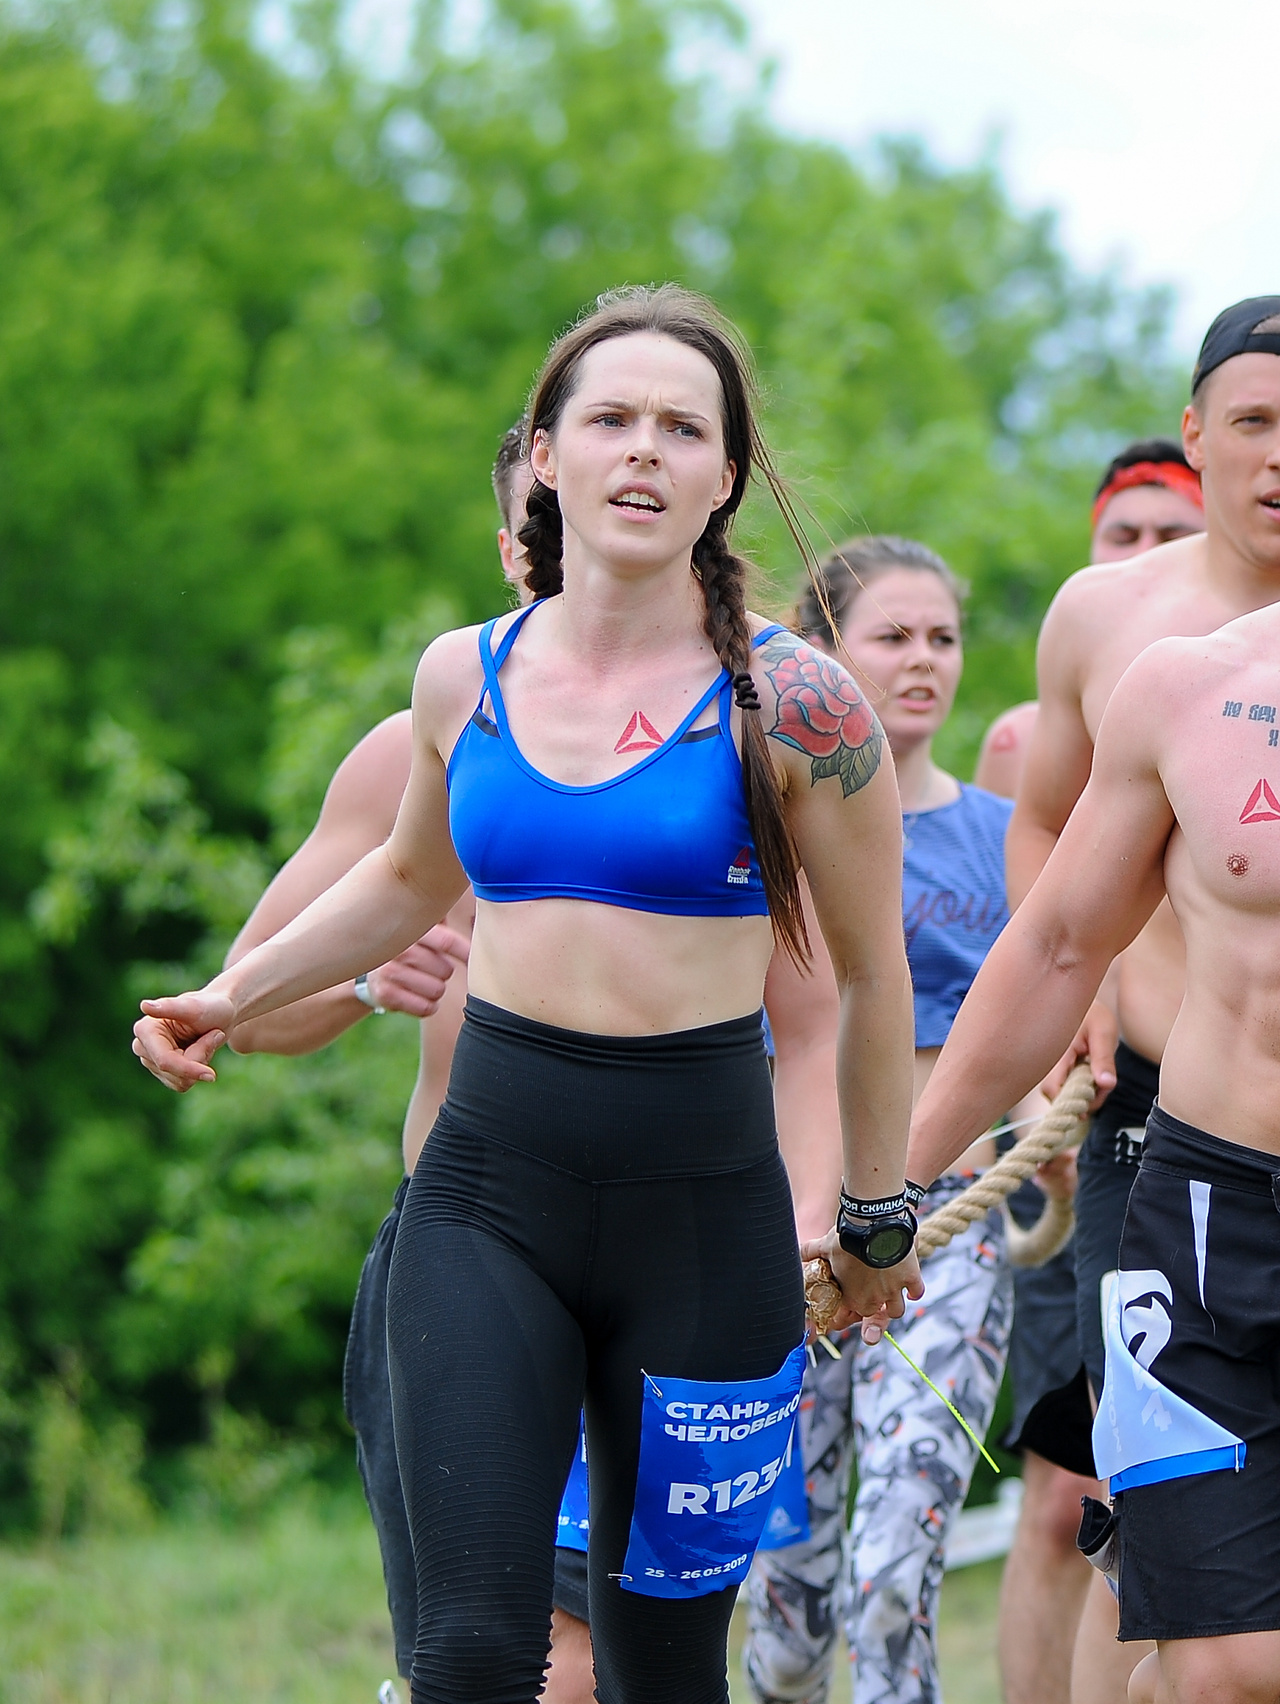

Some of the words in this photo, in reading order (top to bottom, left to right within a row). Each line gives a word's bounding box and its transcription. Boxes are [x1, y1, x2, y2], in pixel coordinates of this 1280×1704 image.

[861, 1198, 904, 1213] СКИДКА
[665, 1394, 801, 1442] ЧЕЛОВЕКО
[666, 1401, 770, 1420] СТАНЬ
[667, 1453, 788, 1515] R123
[645, 1567, 665, 1578] 25
